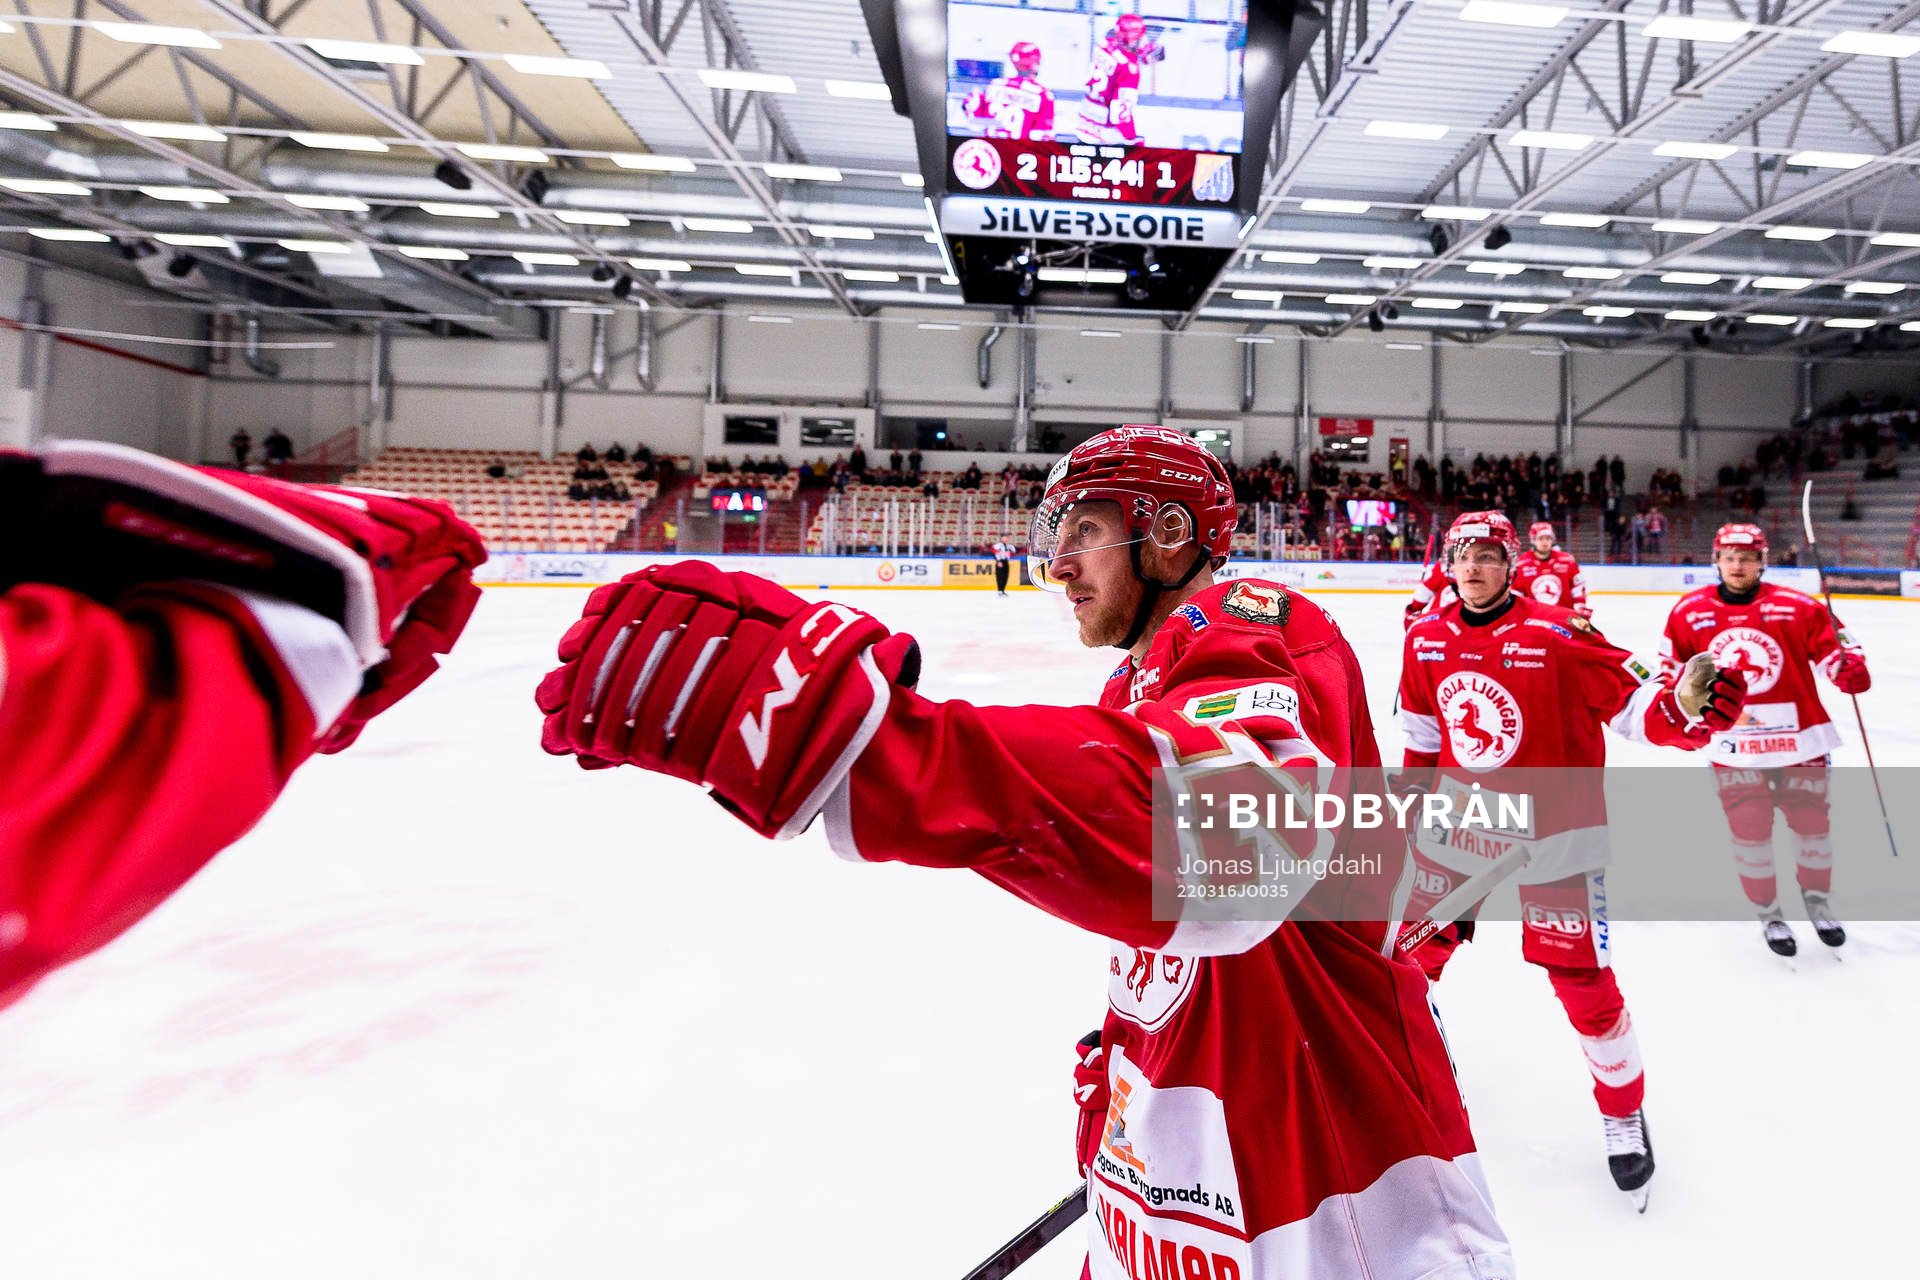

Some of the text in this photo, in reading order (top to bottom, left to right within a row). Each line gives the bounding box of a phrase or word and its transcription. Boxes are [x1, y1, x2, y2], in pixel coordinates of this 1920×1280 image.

[1016, 153, 1176, 188] 2 15:44 1
[1160, 468, 1204, 483] CCM
[899, 564, 928, 576] PS
[1740, 737, 1798, 754] KALMAR
[1527, 904, 1583, 935] EAB
[1127, 1166, 1210, 1206] Byggnads
[1214, 1192, 1235, 1217] AB
